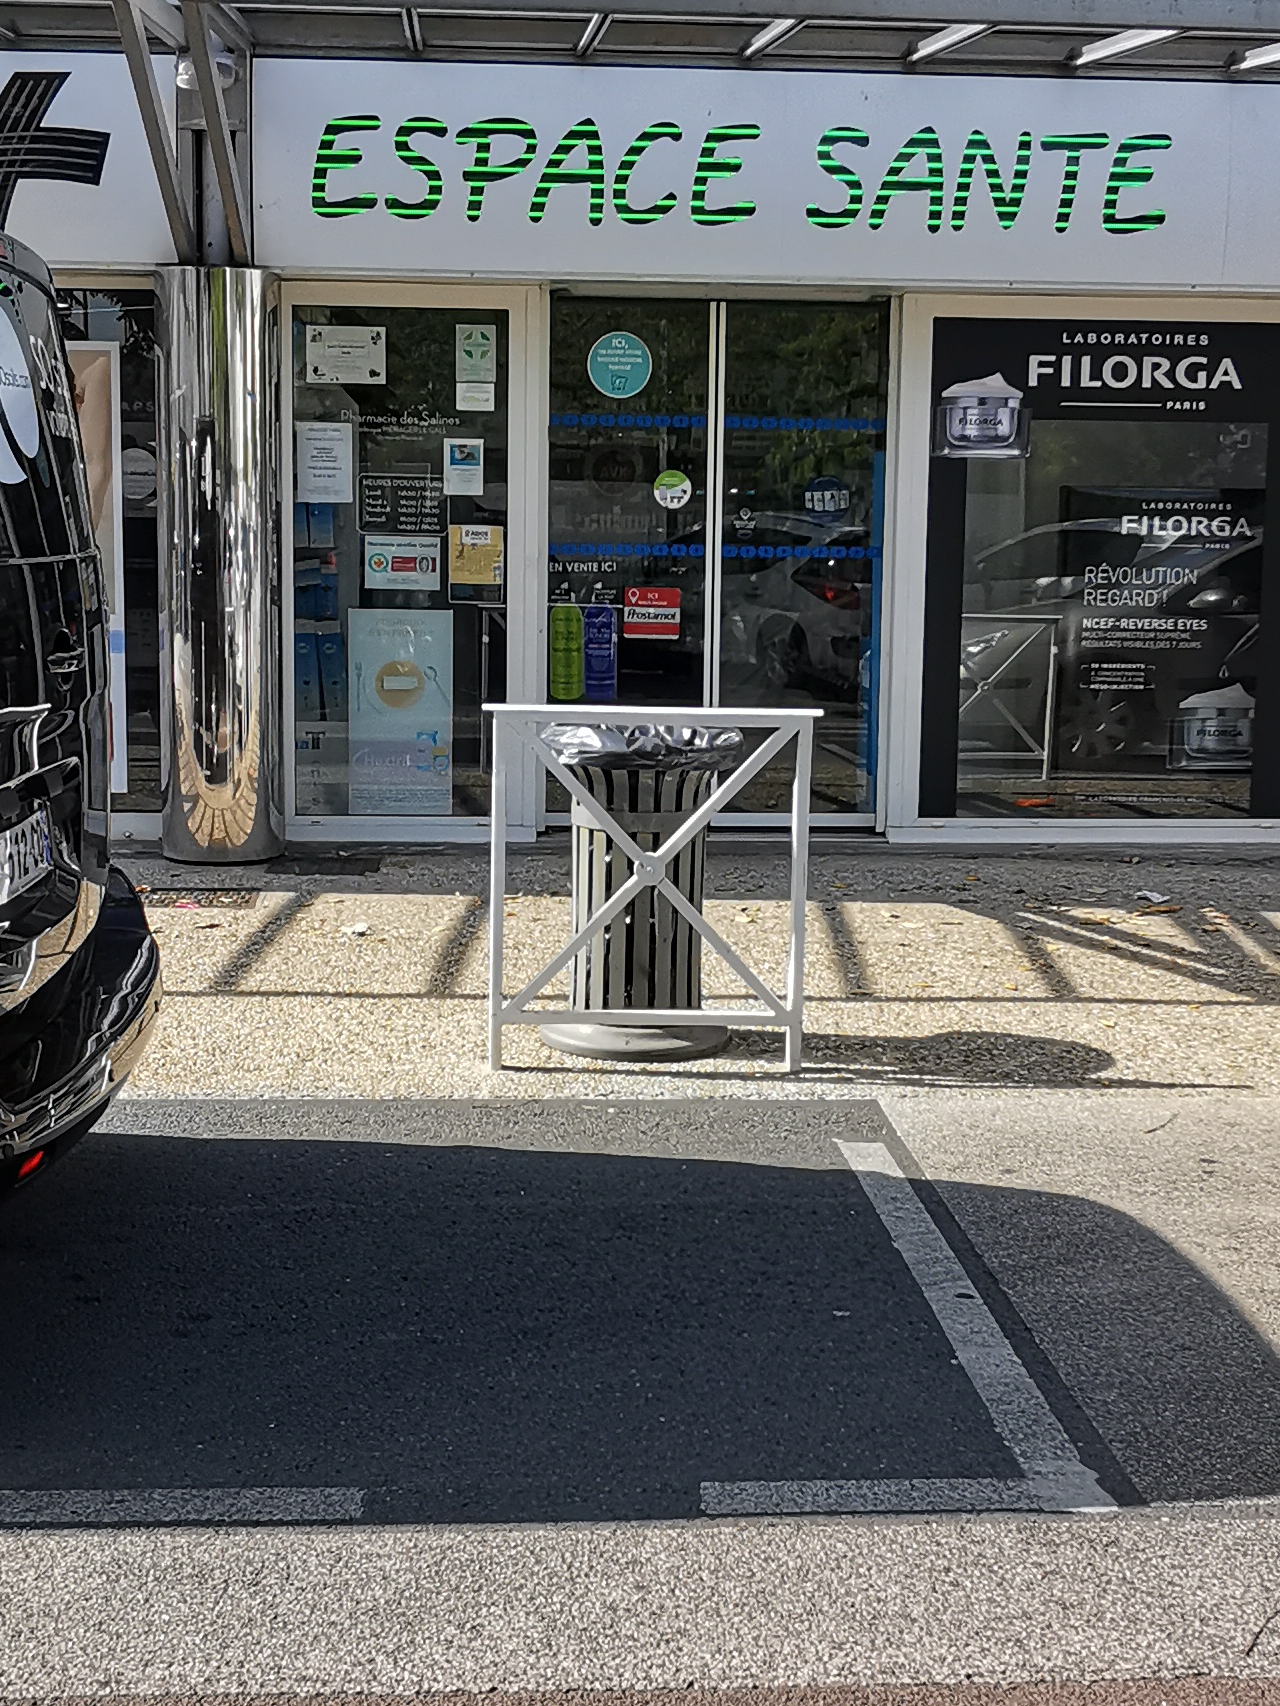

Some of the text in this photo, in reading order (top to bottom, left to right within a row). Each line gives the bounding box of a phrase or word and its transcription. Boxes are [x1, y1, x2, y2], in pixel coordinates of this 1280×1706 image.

[312, 114, 1174, 235] ESPACE SANTE
[1061, 331, 1210, 346] LABORATOIRES
[1027, 354, 1243, 390] FILORGA
[1166, 400, 1207, 411] PARIS
[340, 408, 398, 424] Pharmacie
[958, 417, 1005, 428] FILORGA
[1141, 502, 1233, 511] LABORATOIRES
[1120, 515, 1253, 537] FILORGA
[565, 562, 599, 573] VENTE
[601, 562, 617, 573] ICI
[1084, 562, 1198, 585] RÉVOLUTION
[1082, 617, 1208, 631] NCEF-REVERSE EYES
